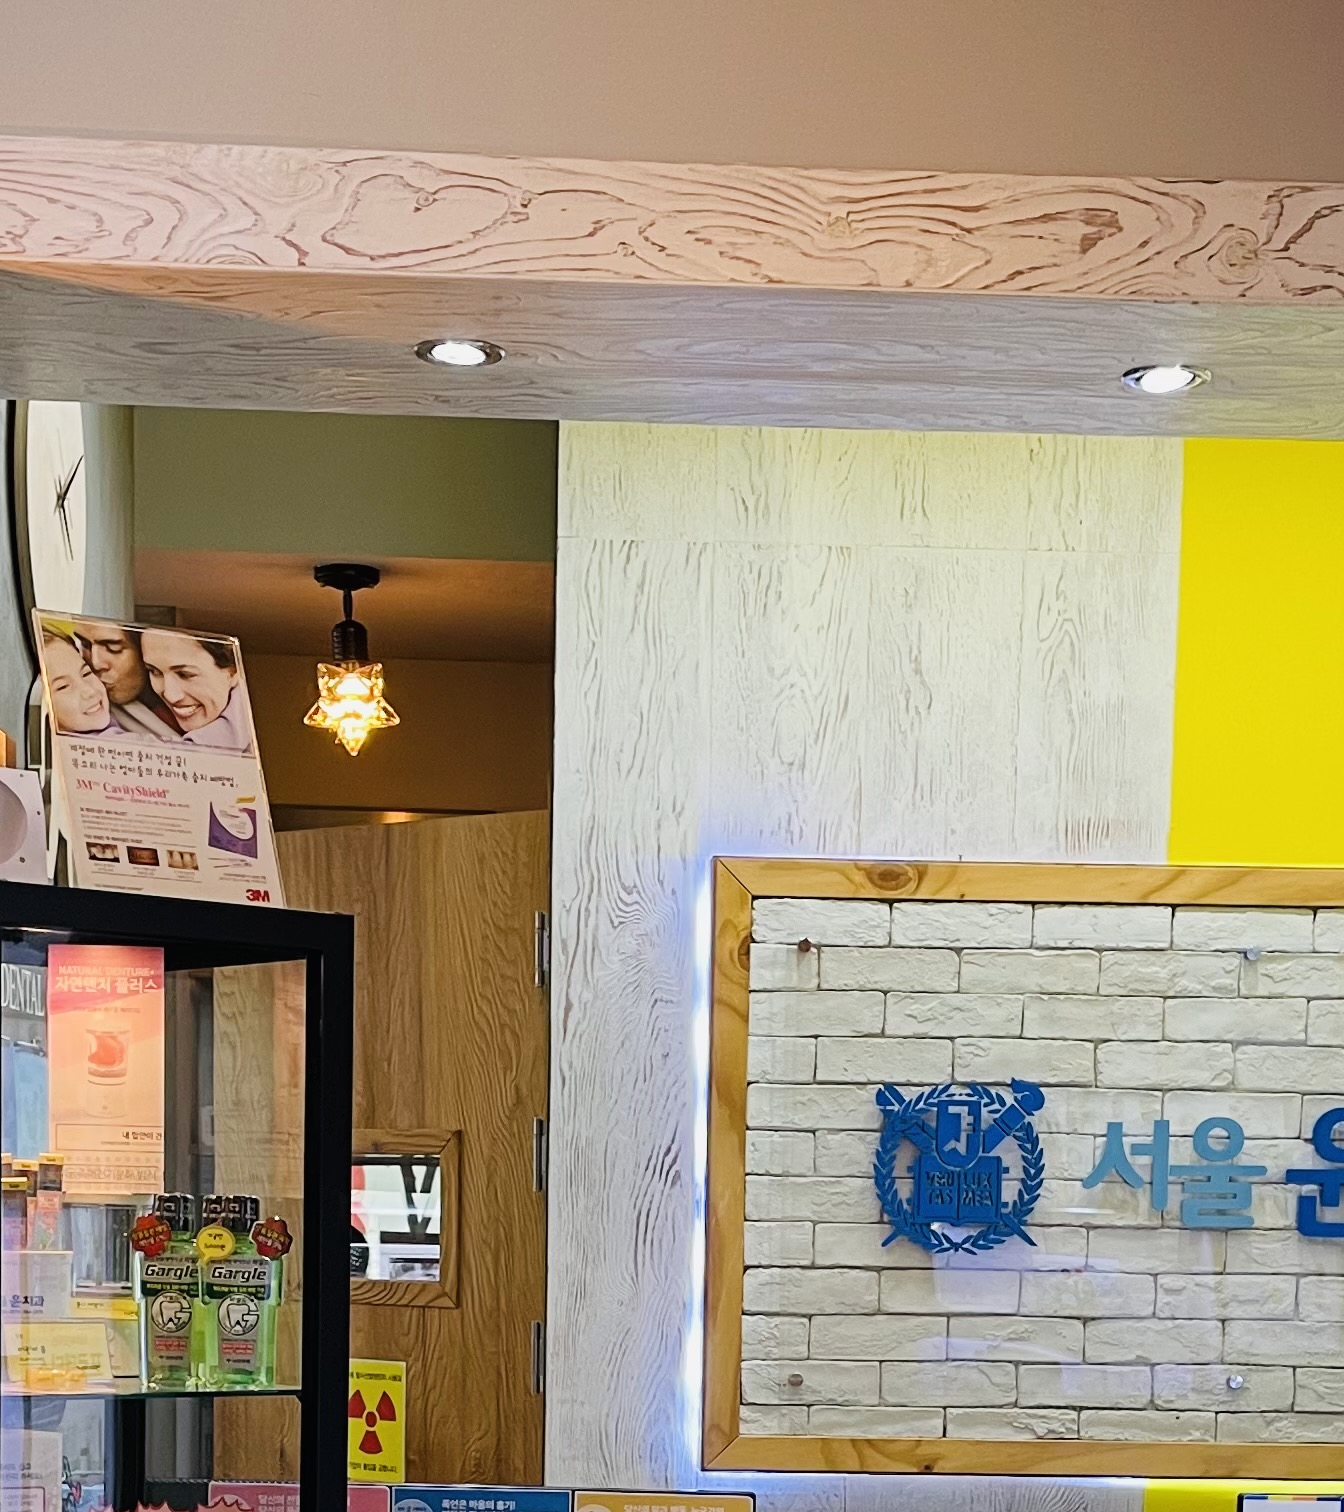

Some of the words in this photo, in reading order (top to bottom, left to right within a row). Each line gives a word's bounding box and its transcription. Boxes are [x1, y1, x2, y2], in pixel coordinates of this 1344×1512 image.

[245, 889, 270, 903] 3M
[1081, 1117, 1268, 1230] 서울
[145, 1265, 199, 1280] Gargle
[211, 1266, 267, 1283] Gargle
